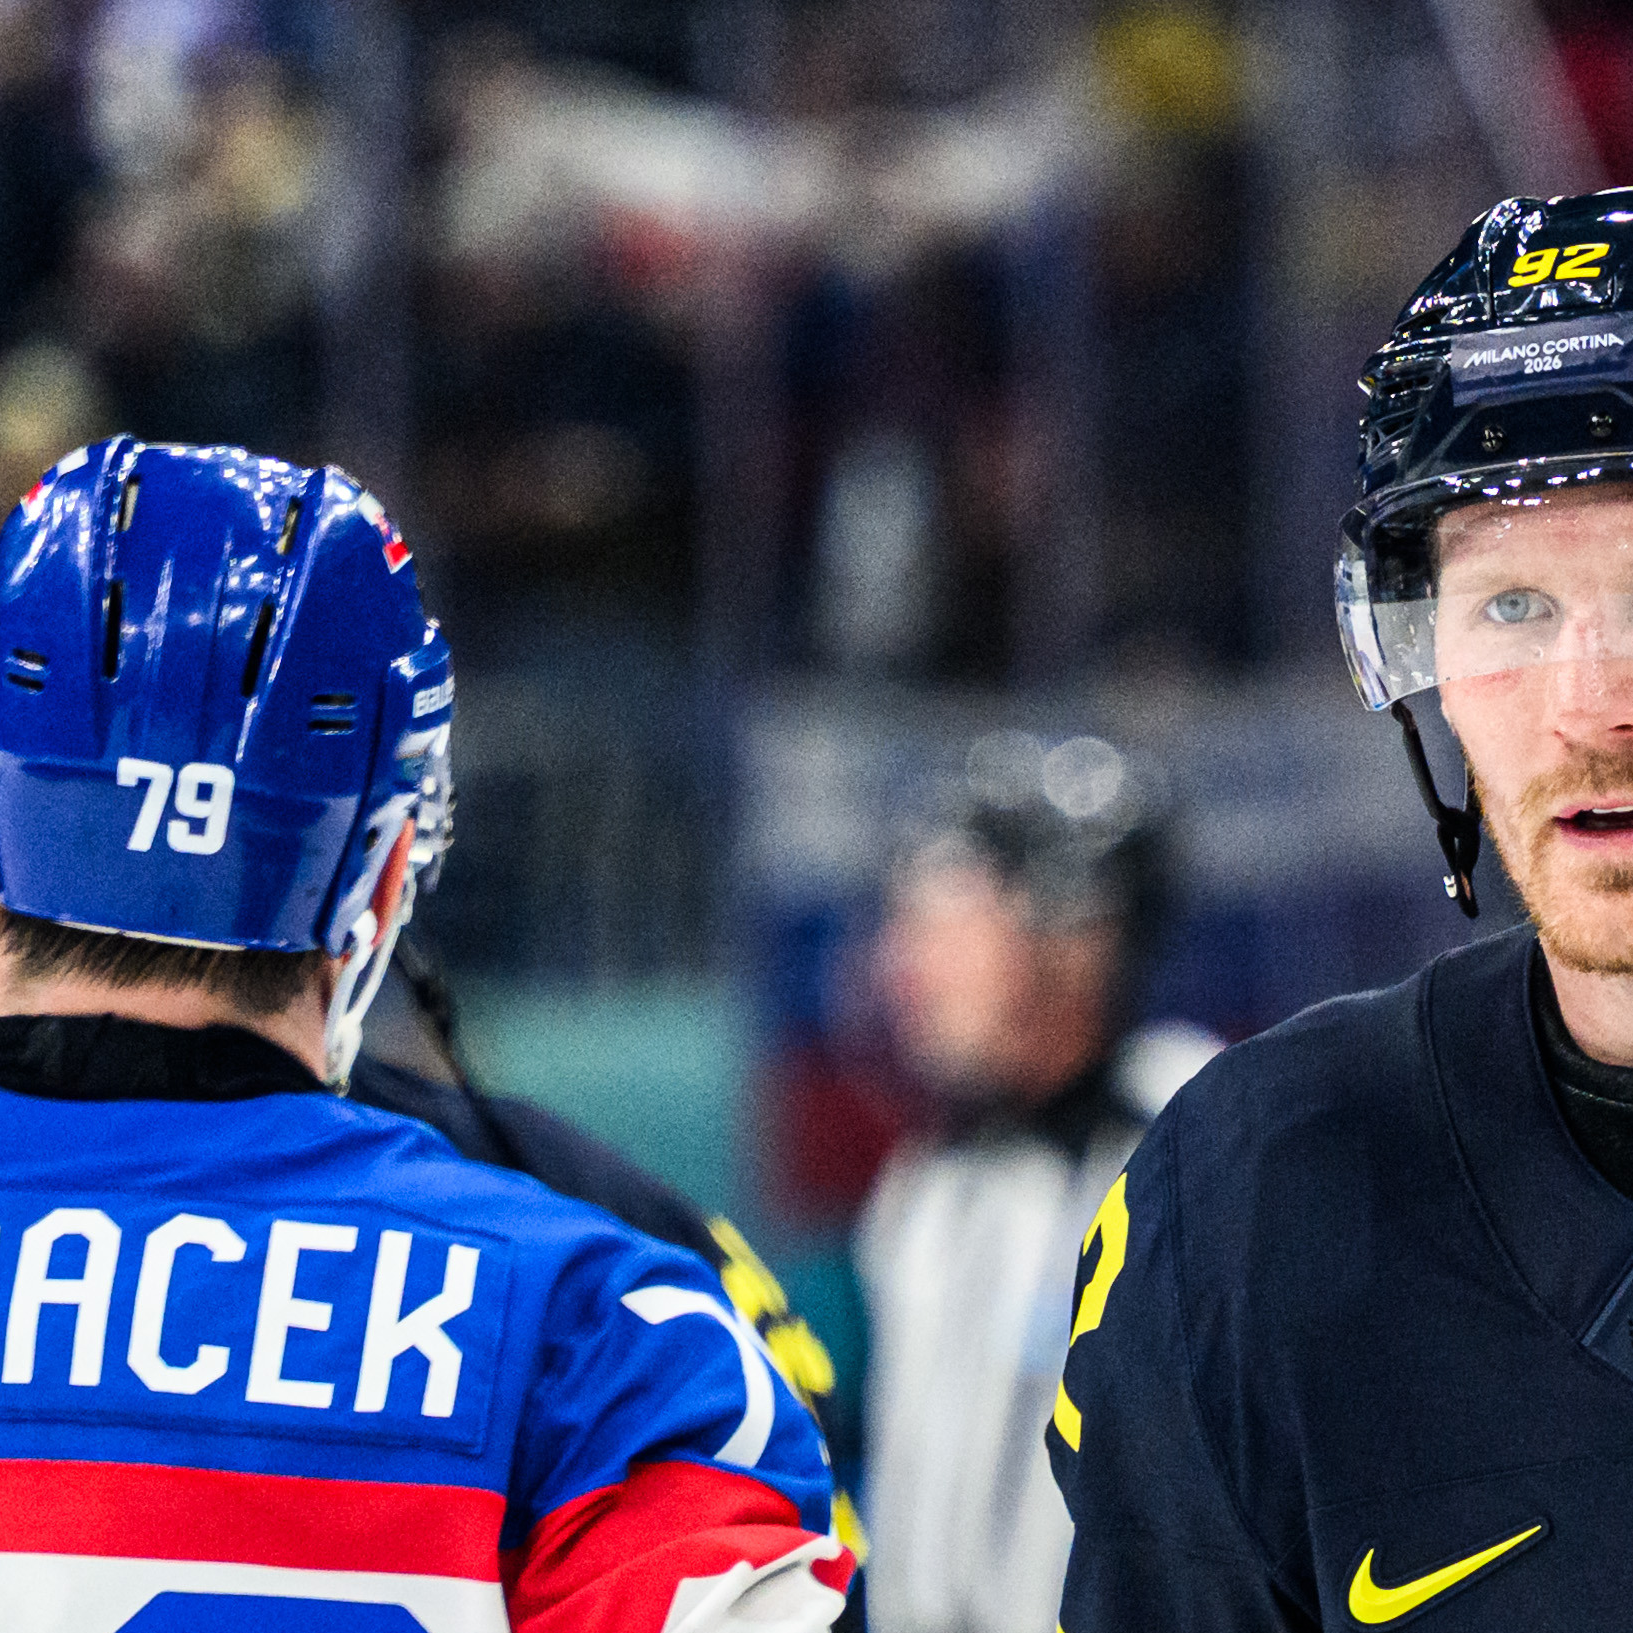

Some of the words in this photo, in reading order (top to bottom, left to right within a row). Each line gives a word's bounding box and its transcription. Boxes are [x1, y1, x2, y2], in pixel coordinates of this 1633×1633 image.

[1508, 243, 1610, 287] 92
[1463, 343, 1540, 368] MILANO
[1542, 333, 1624, 355] CORTINA
[1524, 355, 1562, 374] 2026
[116, 757, 235, 855] 79
[621, 1284, 775, 1468] 7
